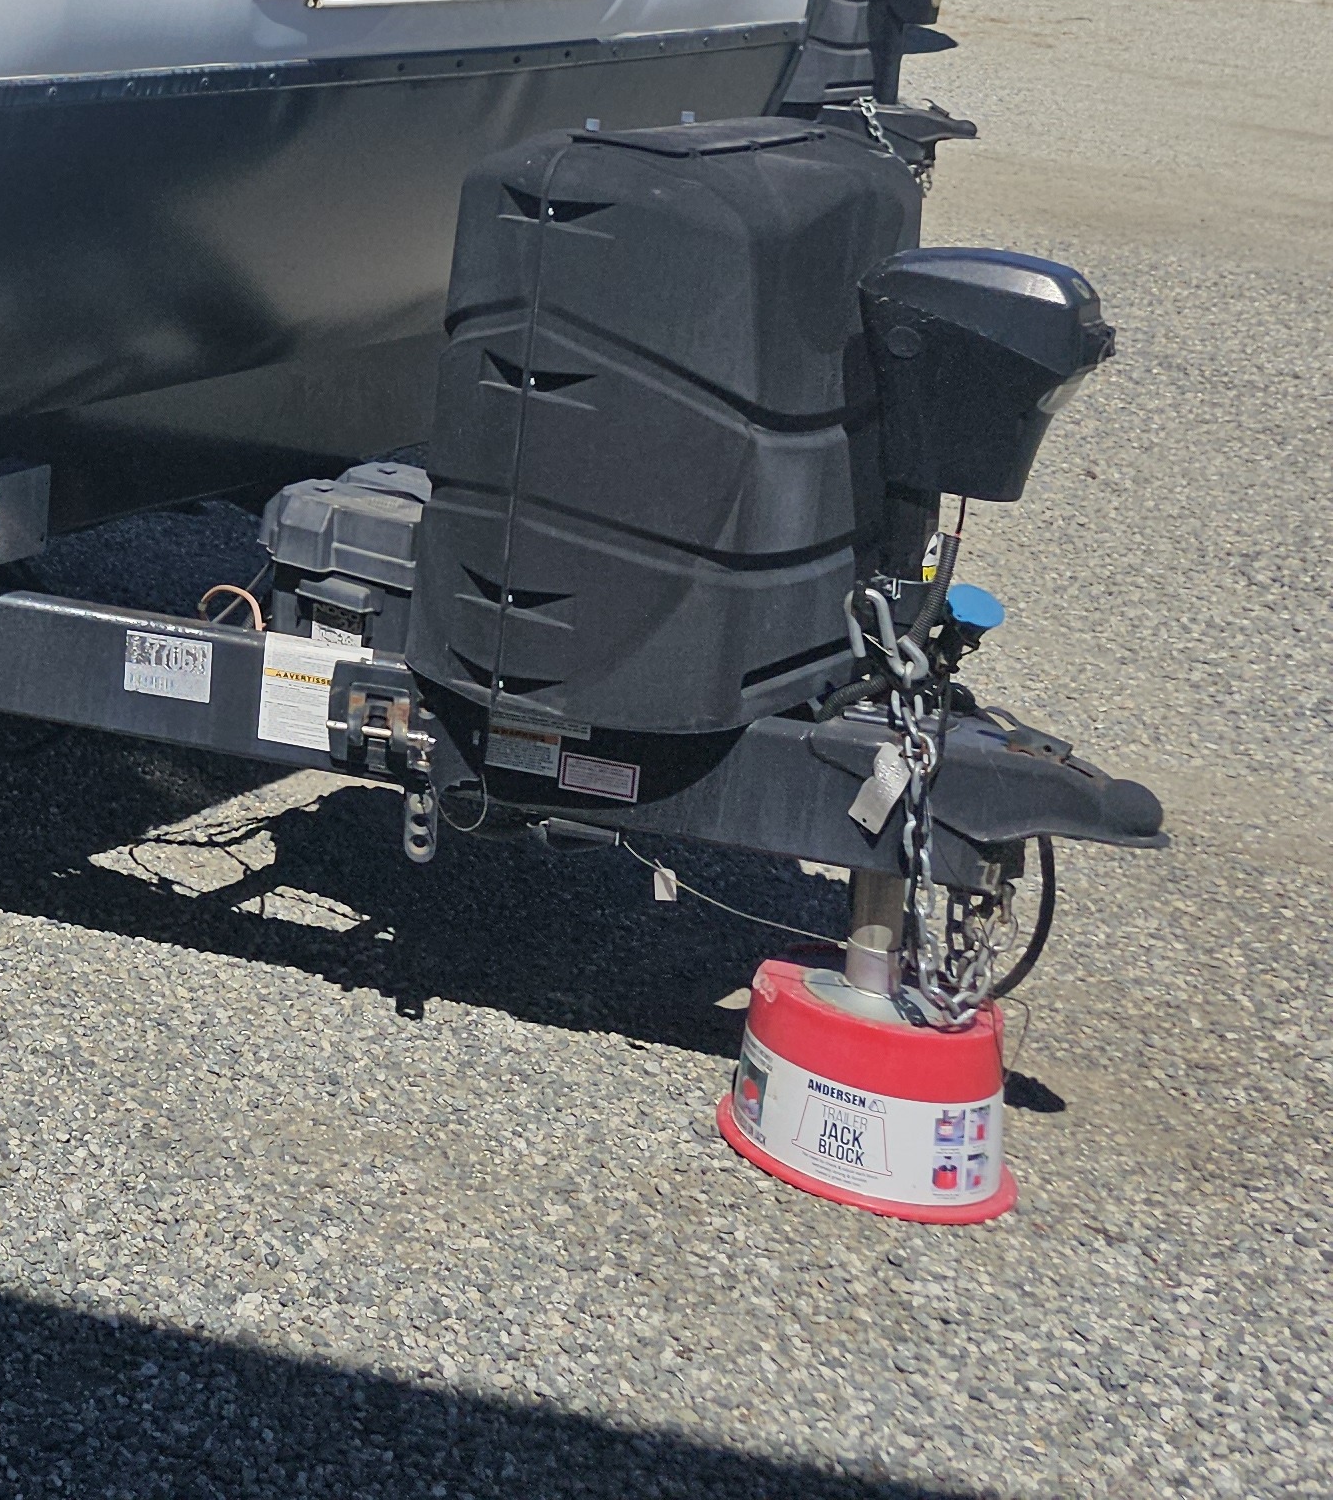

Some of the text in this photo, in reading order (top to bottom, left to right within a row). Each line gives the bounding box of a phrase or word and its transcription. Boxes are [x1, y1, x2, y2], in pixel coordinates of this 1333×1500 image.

[807, 1078, 867, 1108] ANDERSEN
[822, 1103, 868, 1131] TRAILER
[820, 1119, 864, 1150] JACK
[818, 1137, 865, 1167] BLOCK
